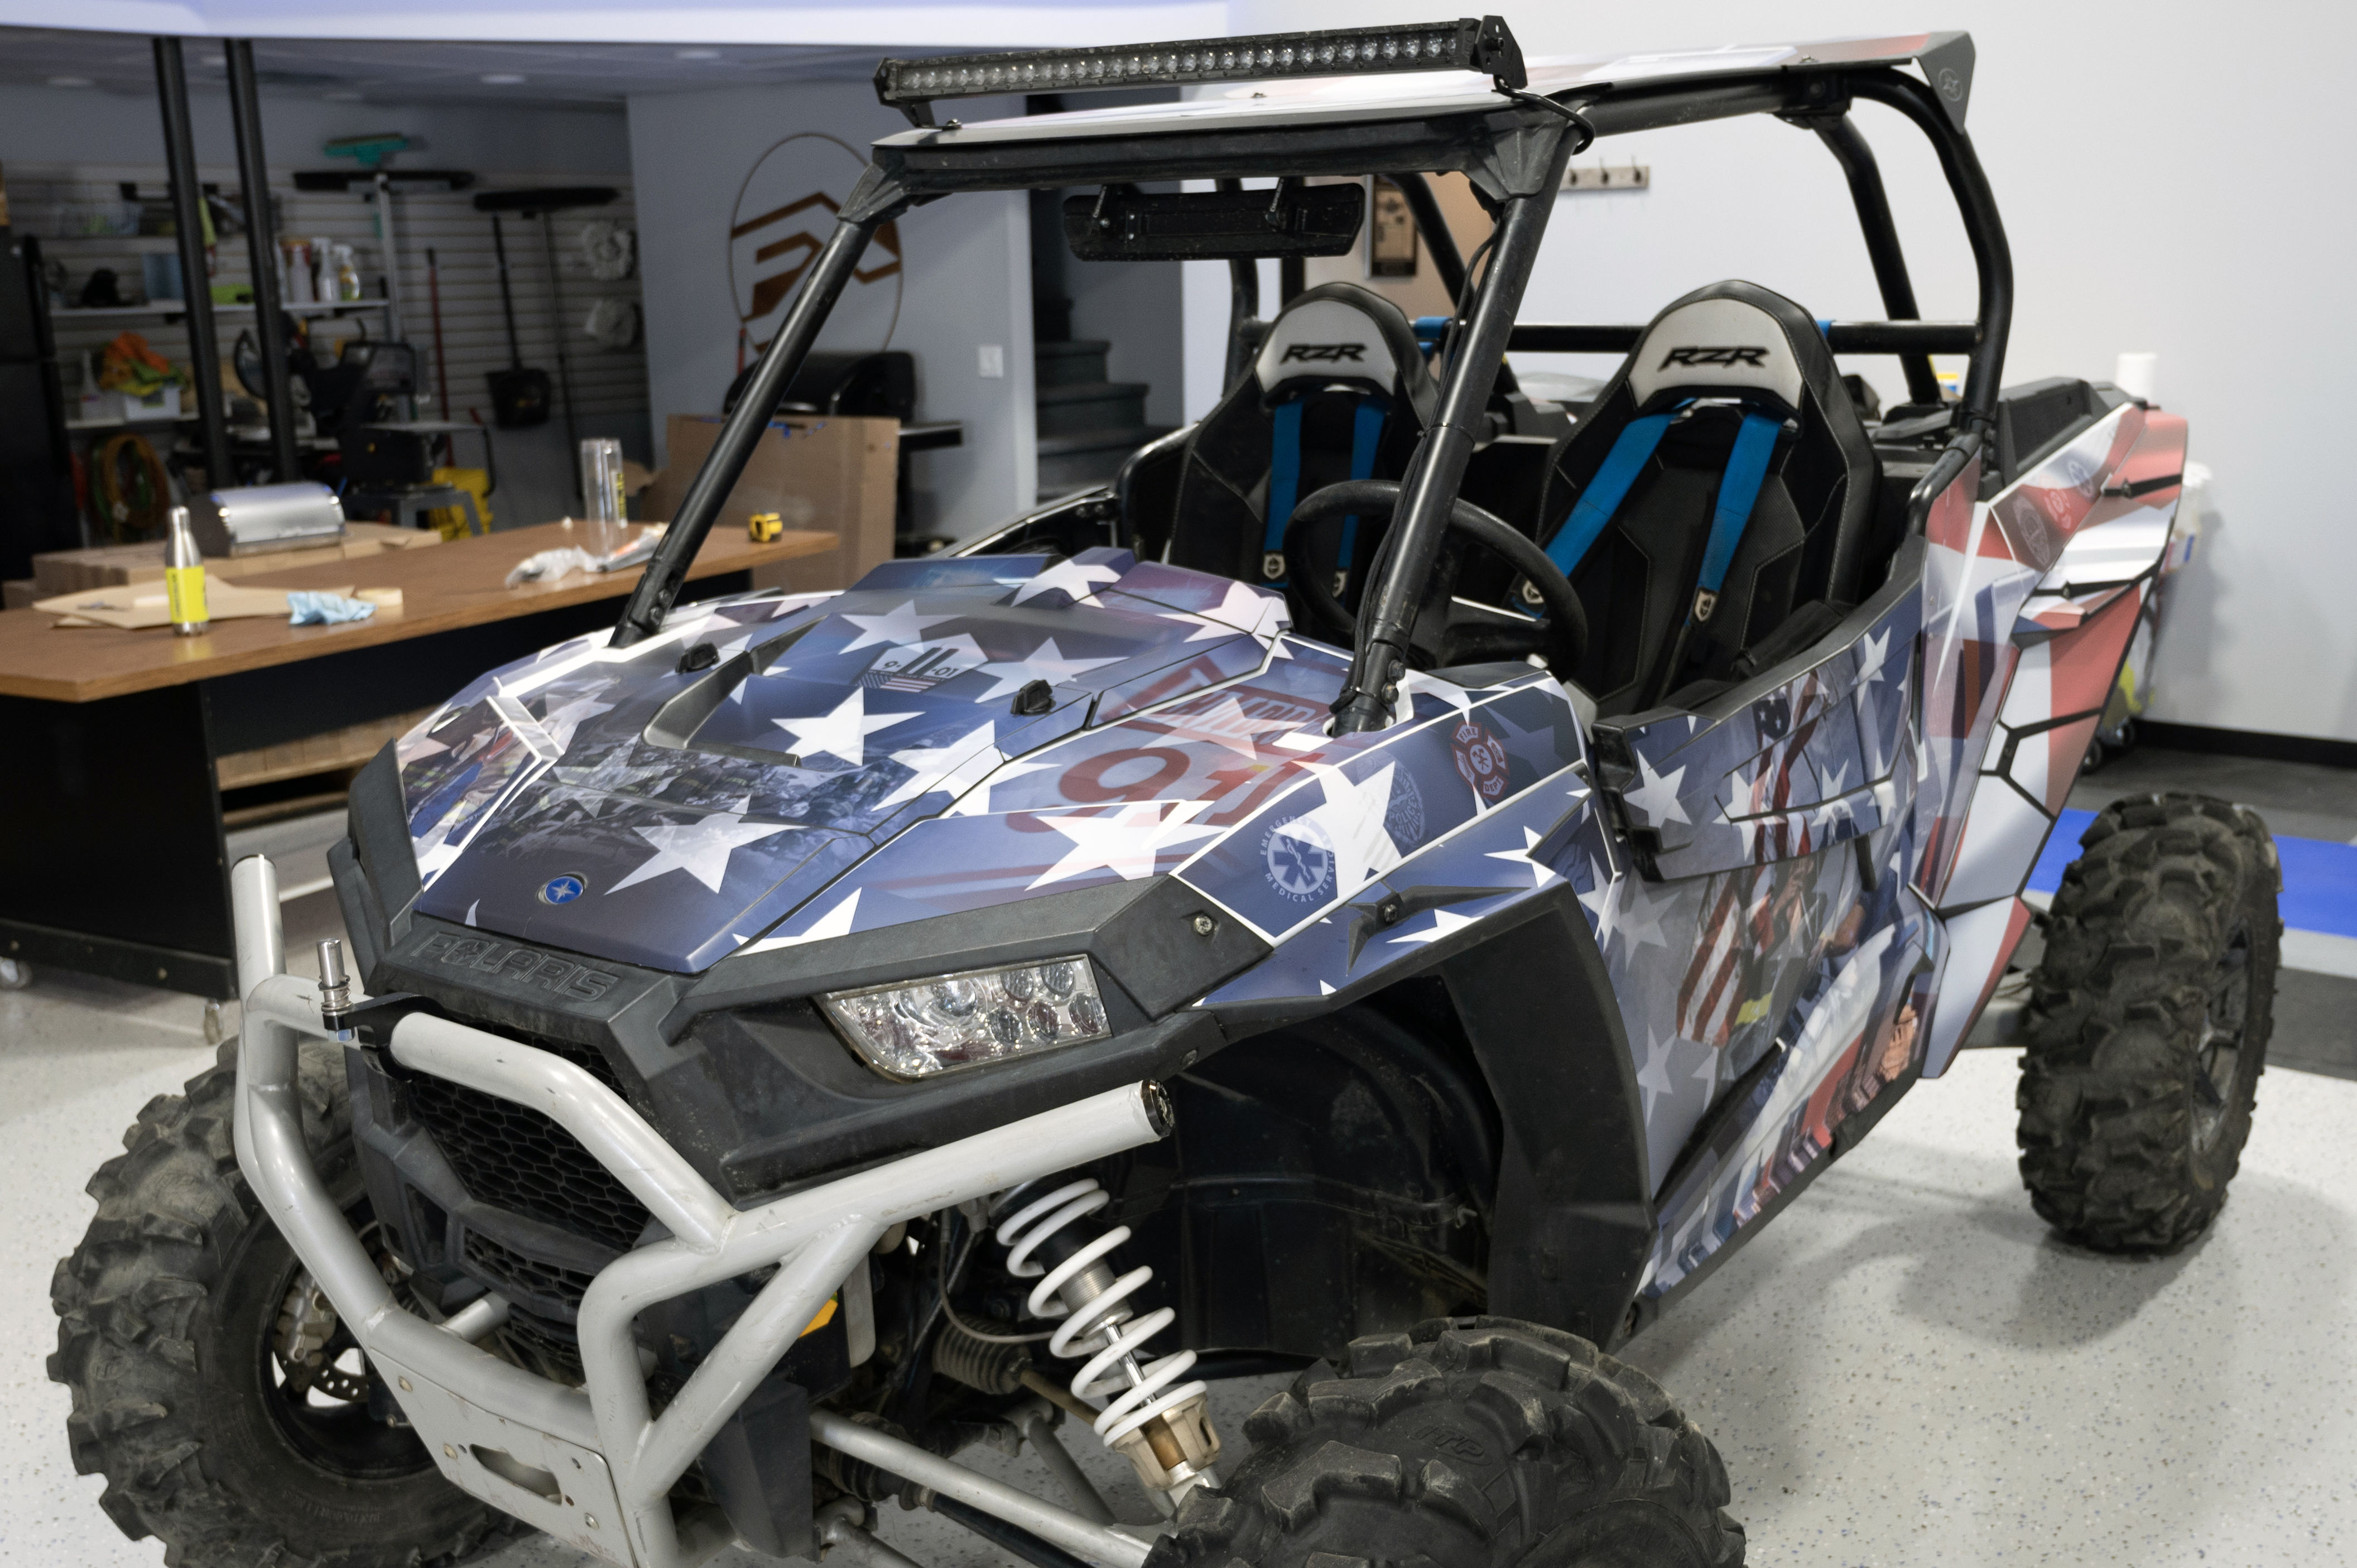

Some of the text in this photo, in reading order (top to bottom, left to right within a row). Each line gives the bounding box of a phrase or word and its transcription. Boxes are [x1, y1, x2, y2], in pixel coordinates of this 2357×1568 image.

[1279, 343, 1367, 365] RZR
[1657, 346, 1769, 373] RZR
[1459, 727, 1477, 742] FIRE
[1484, 777, 1502, 792] DEPT
[1388, 797, 1418, 825] POLICE
[1260, 815, 1312, 855] EMERGENCY
[1265, 872, 1314, 903] MEDICAL
[410, 931, 620, 1002] POLARIS
[1415, 1426, 1485, 1458] ITP
